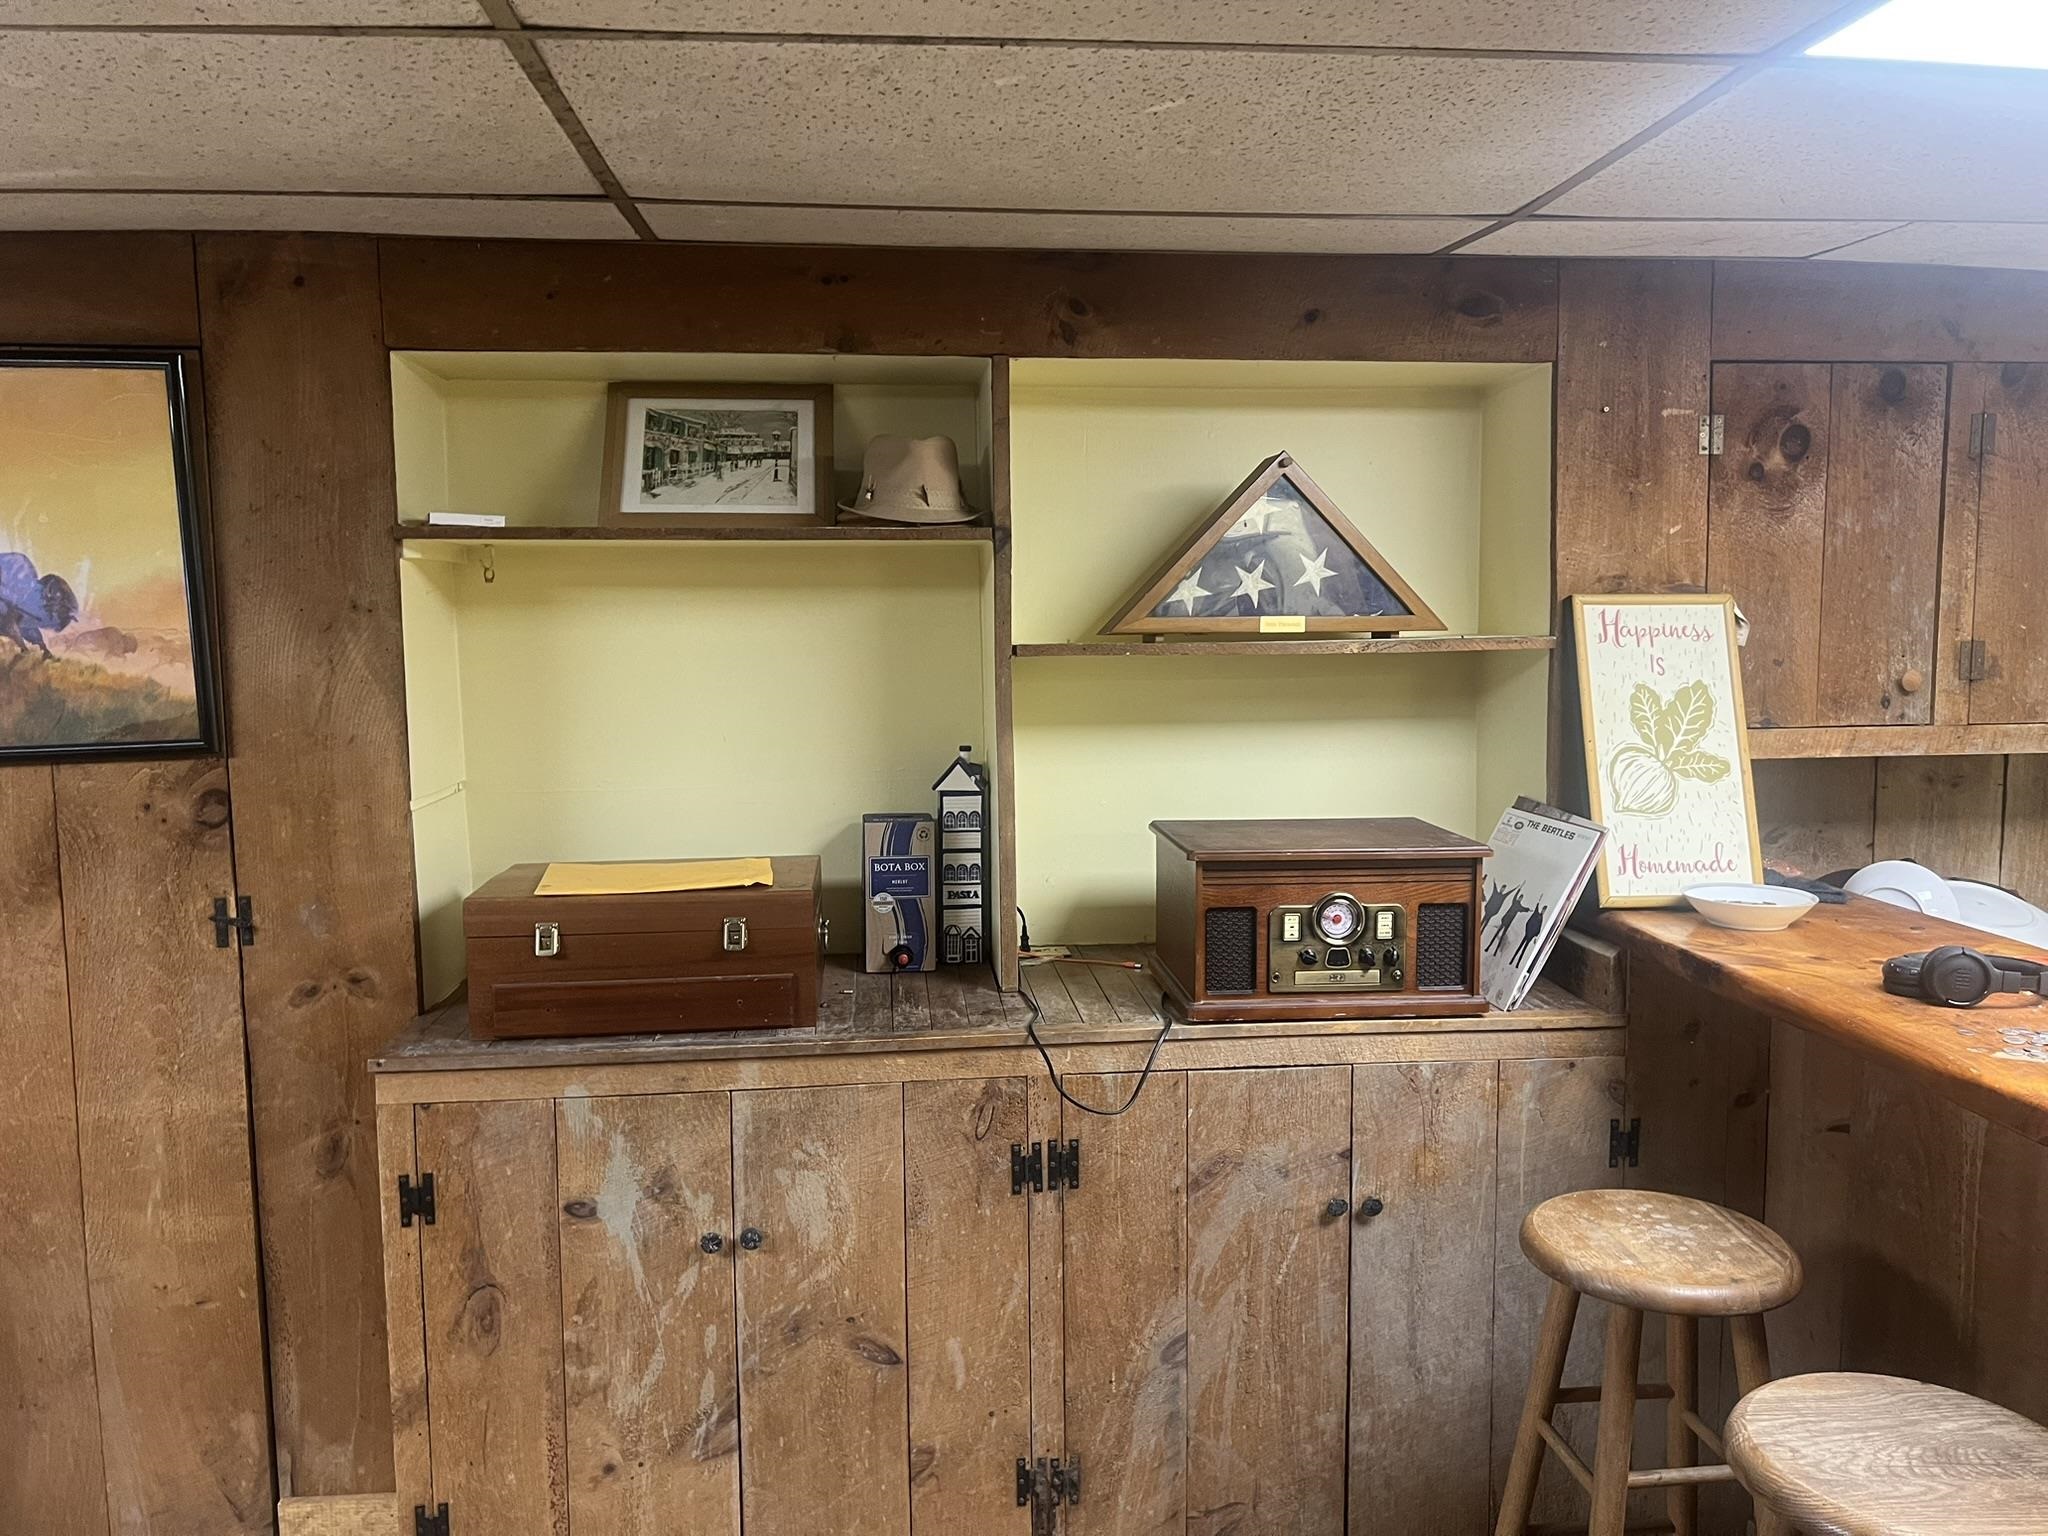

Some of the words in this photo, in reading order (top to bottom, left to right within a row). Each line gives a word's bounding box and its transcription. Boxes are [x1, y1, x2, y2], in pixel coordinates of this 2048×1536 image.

[1597, 608, 1715, 649] Happiness
[1526, 820, 1542, 831] THE
[1541, 824, 1576, 841] BEATLES
[874, 863, 902, 872] BOTA
[904, 862, 926, 871] BOX
[1616, 841, 1738, 880] Homemade
[946, 890, 980, 900] PASTA
